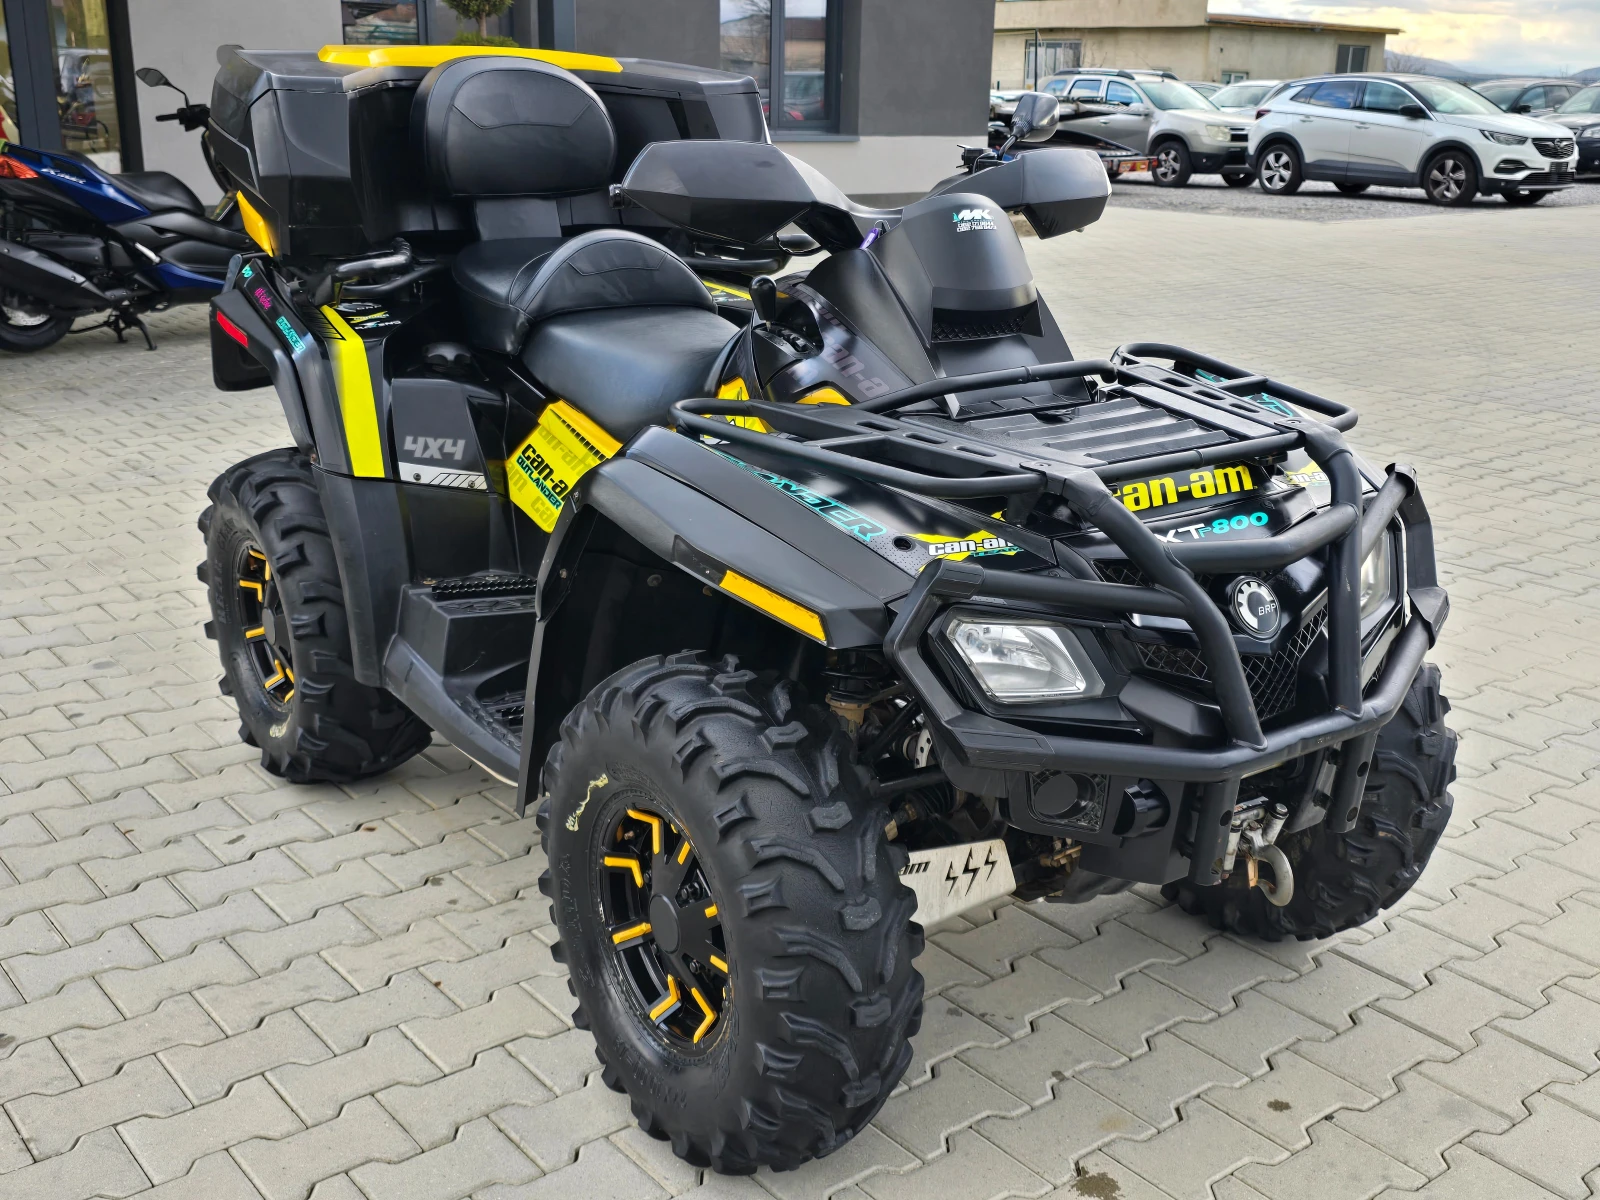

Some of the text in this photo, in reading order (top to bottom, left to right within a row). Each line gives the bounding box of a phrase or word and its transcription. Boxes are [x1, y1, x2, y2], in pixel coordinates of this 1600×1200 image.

[516, 454, 564, 511] OUTLANDER
[521, 443, 569, 501] can-a
[1113, 465, 1254, 512] an-am
[1258, 603, 1277, 616] BRP
